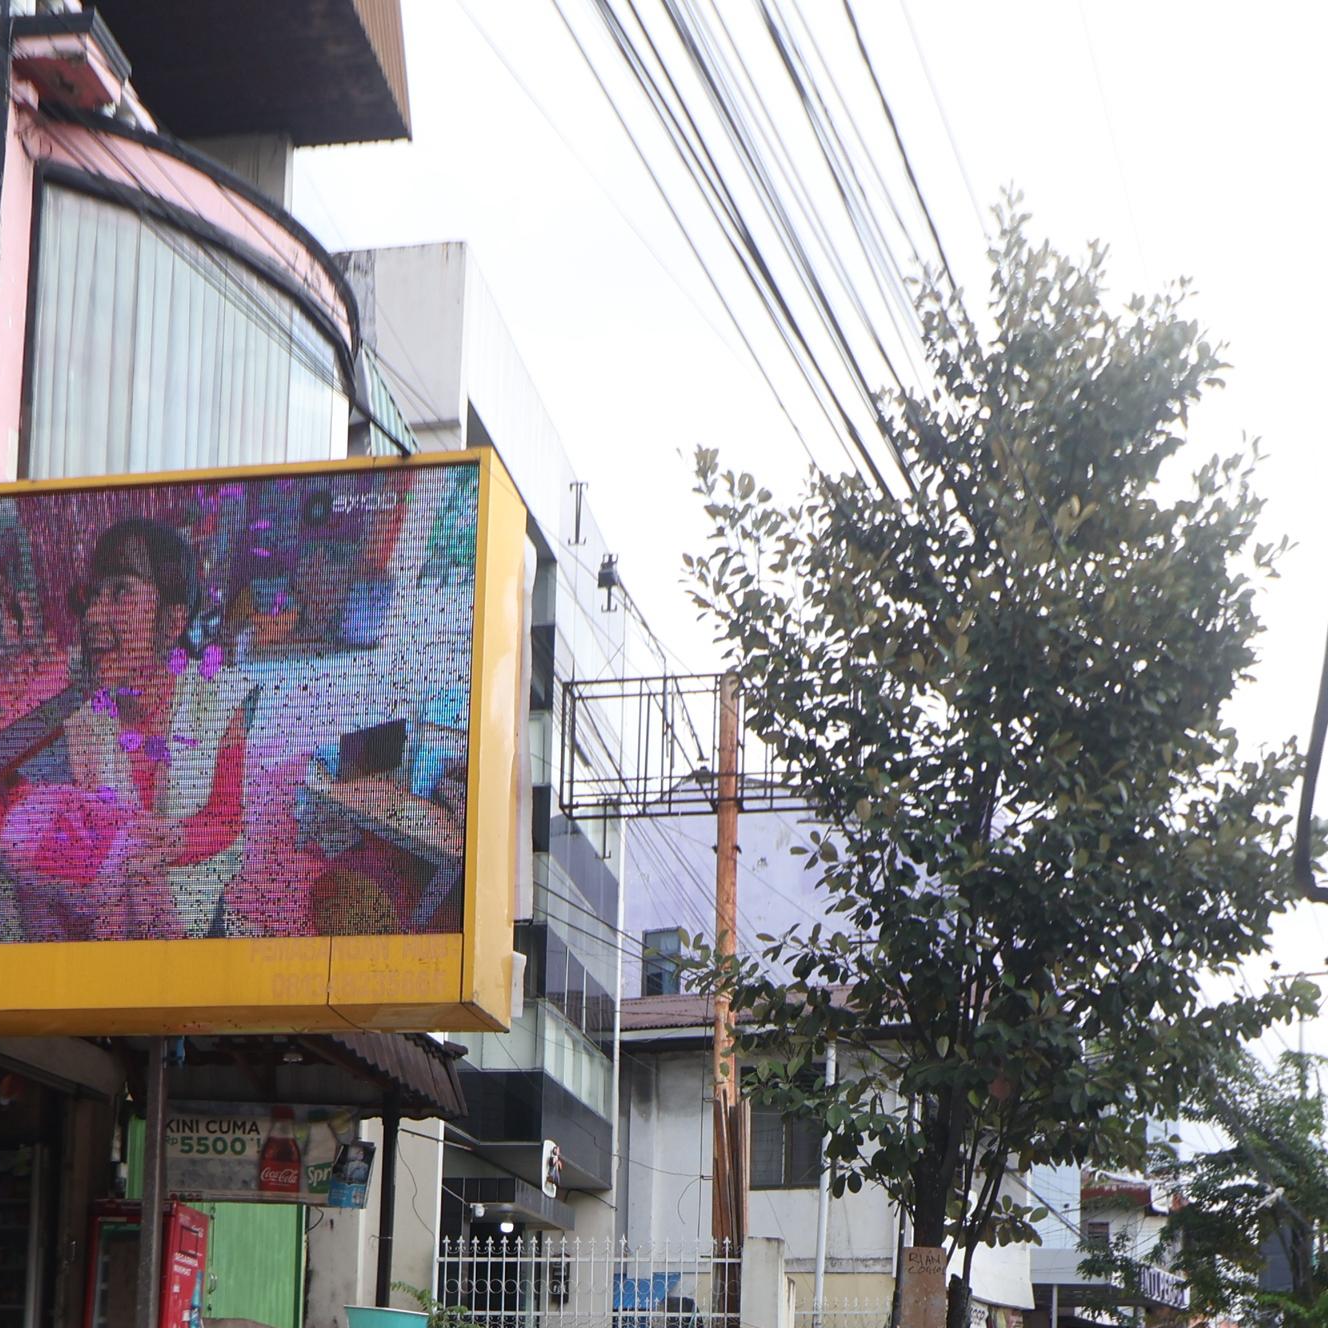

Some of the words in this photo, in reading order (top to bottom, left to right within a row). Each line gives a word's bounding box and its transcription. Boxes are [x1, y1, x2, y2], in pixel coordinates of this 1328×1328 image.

[166, 1120, 200, 1134] KINI
[205, 1120, 261, 1135] CUMA
[179, 1136, 247, 1156] 5500
